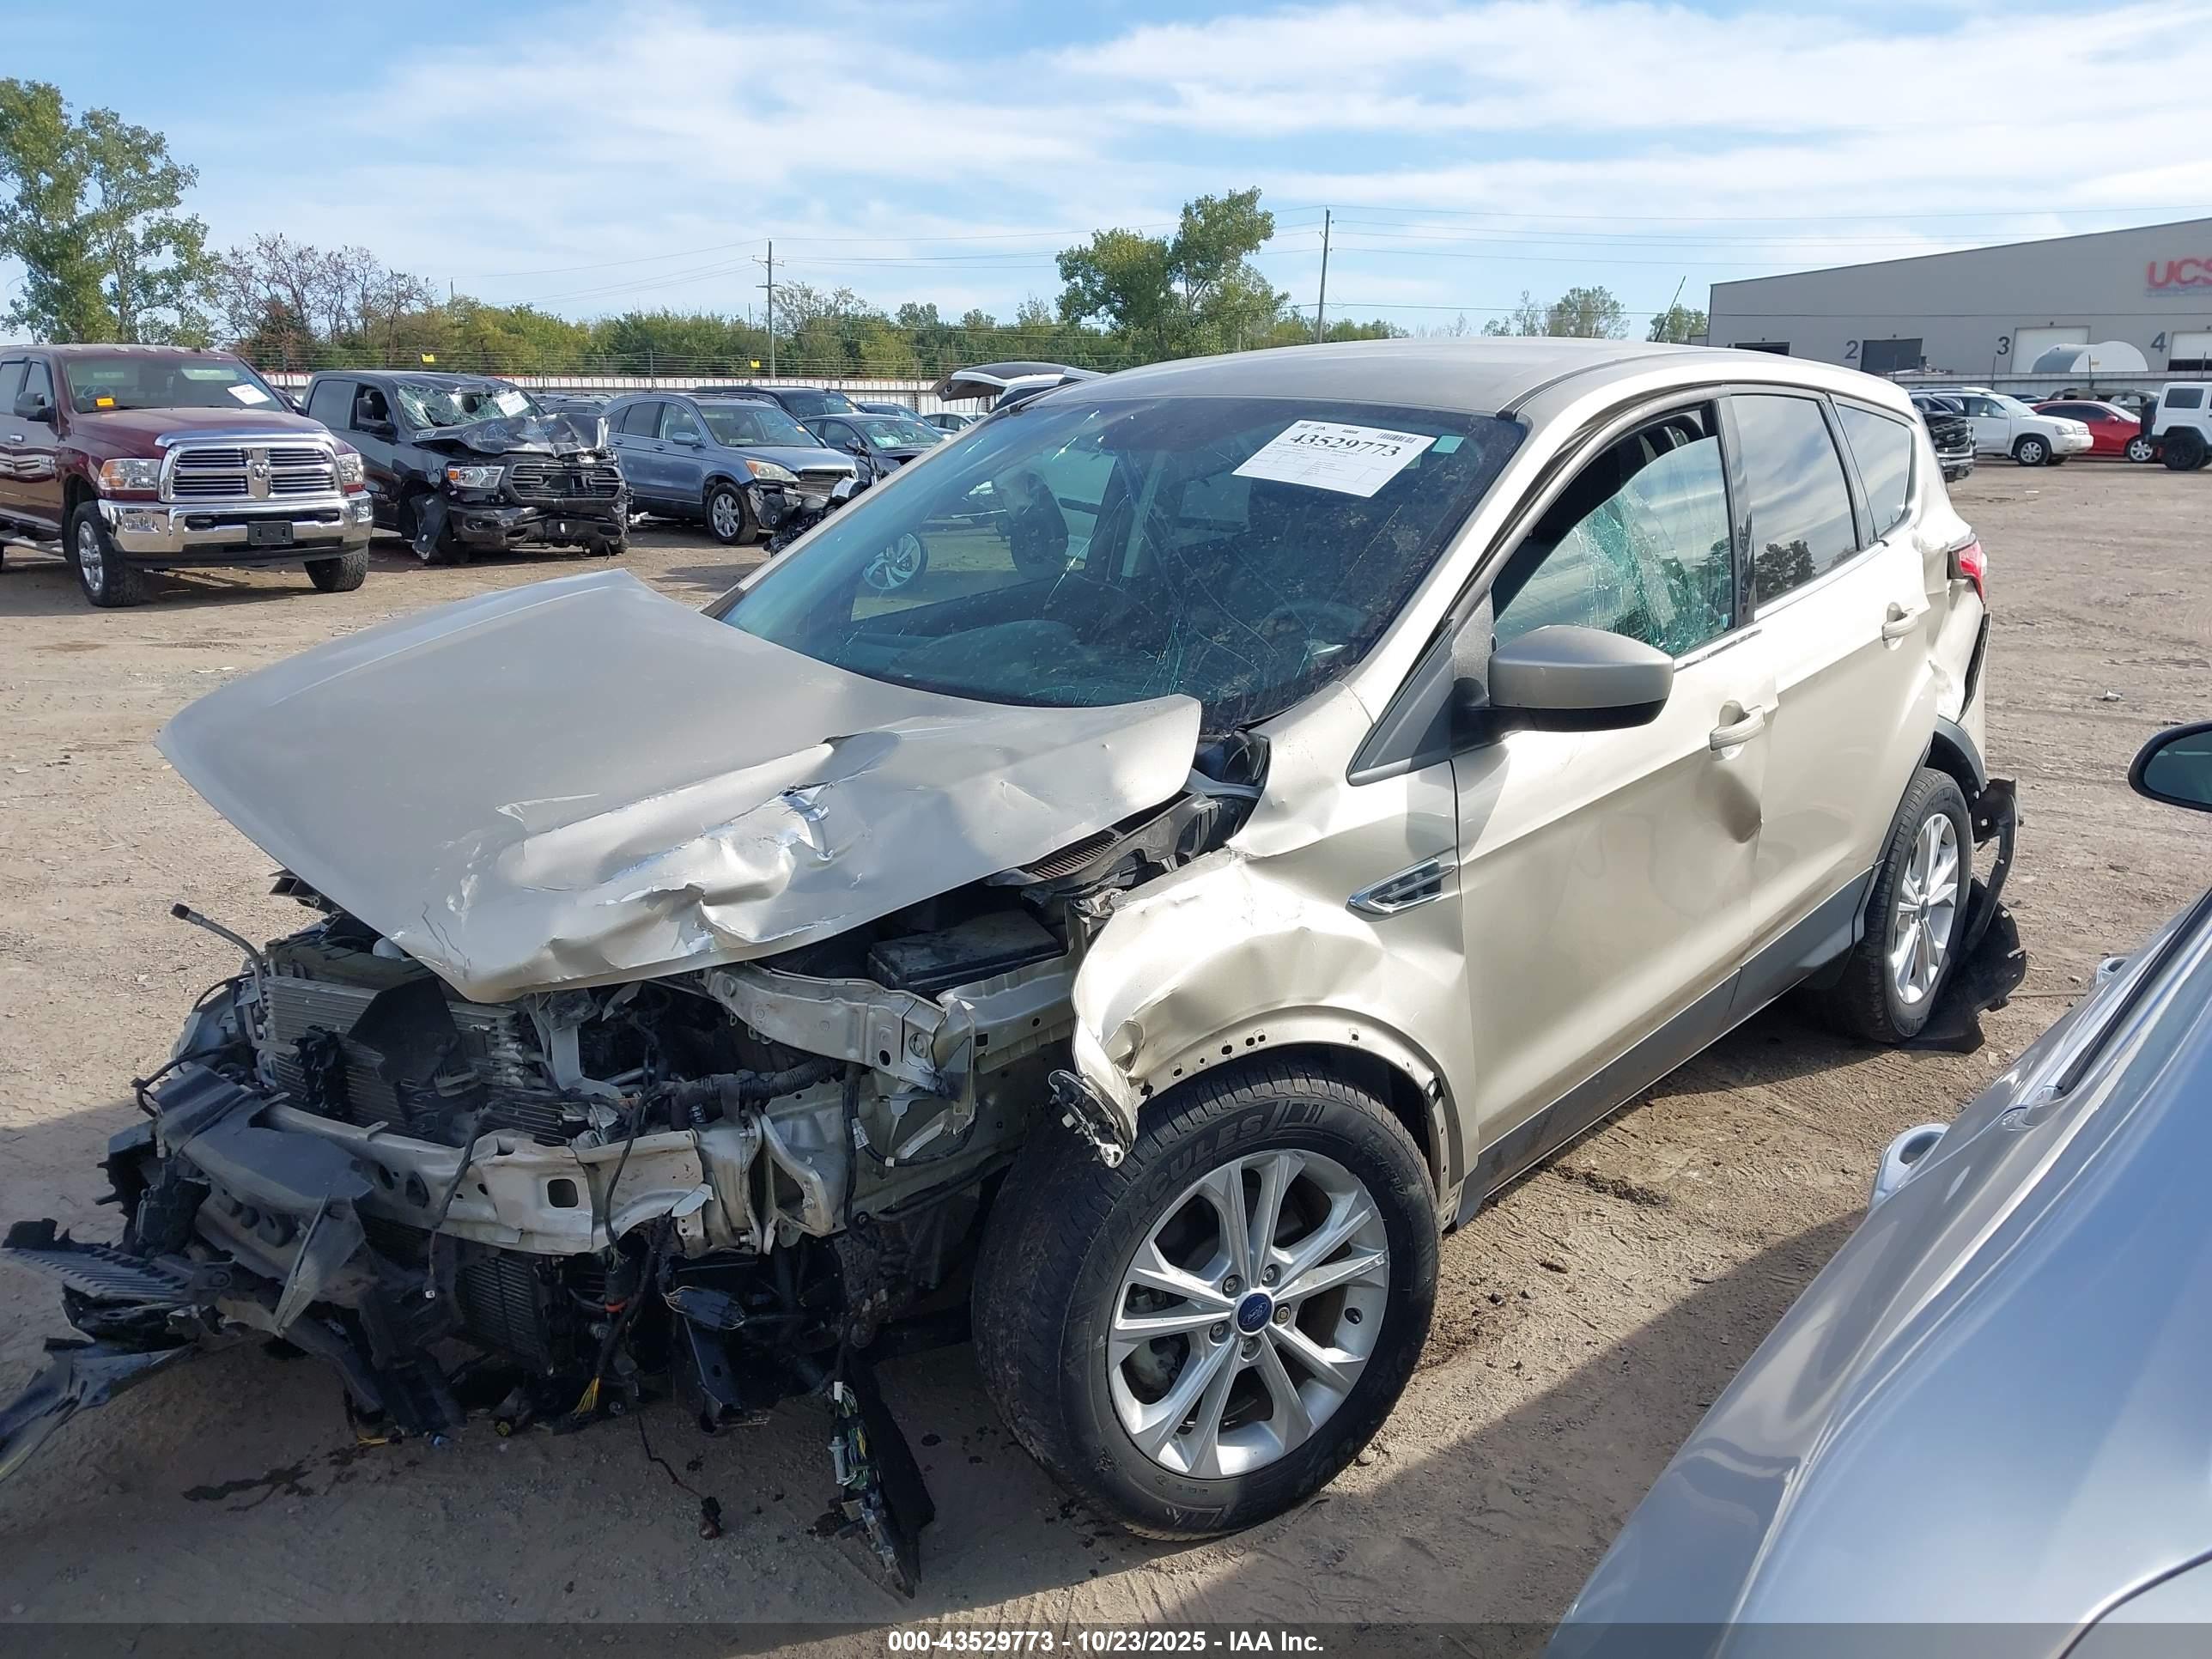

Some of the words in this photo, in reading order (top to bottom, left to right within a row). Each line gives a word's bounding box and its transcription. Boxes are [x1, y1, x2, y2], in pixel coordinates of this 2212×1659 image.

[1844, 339, 1859, 359] 2
[1996, 336, 2011, 356] 3
[2149, 331, 2166, 353] 4
[1289, 433, 1401, 457] 43529773
